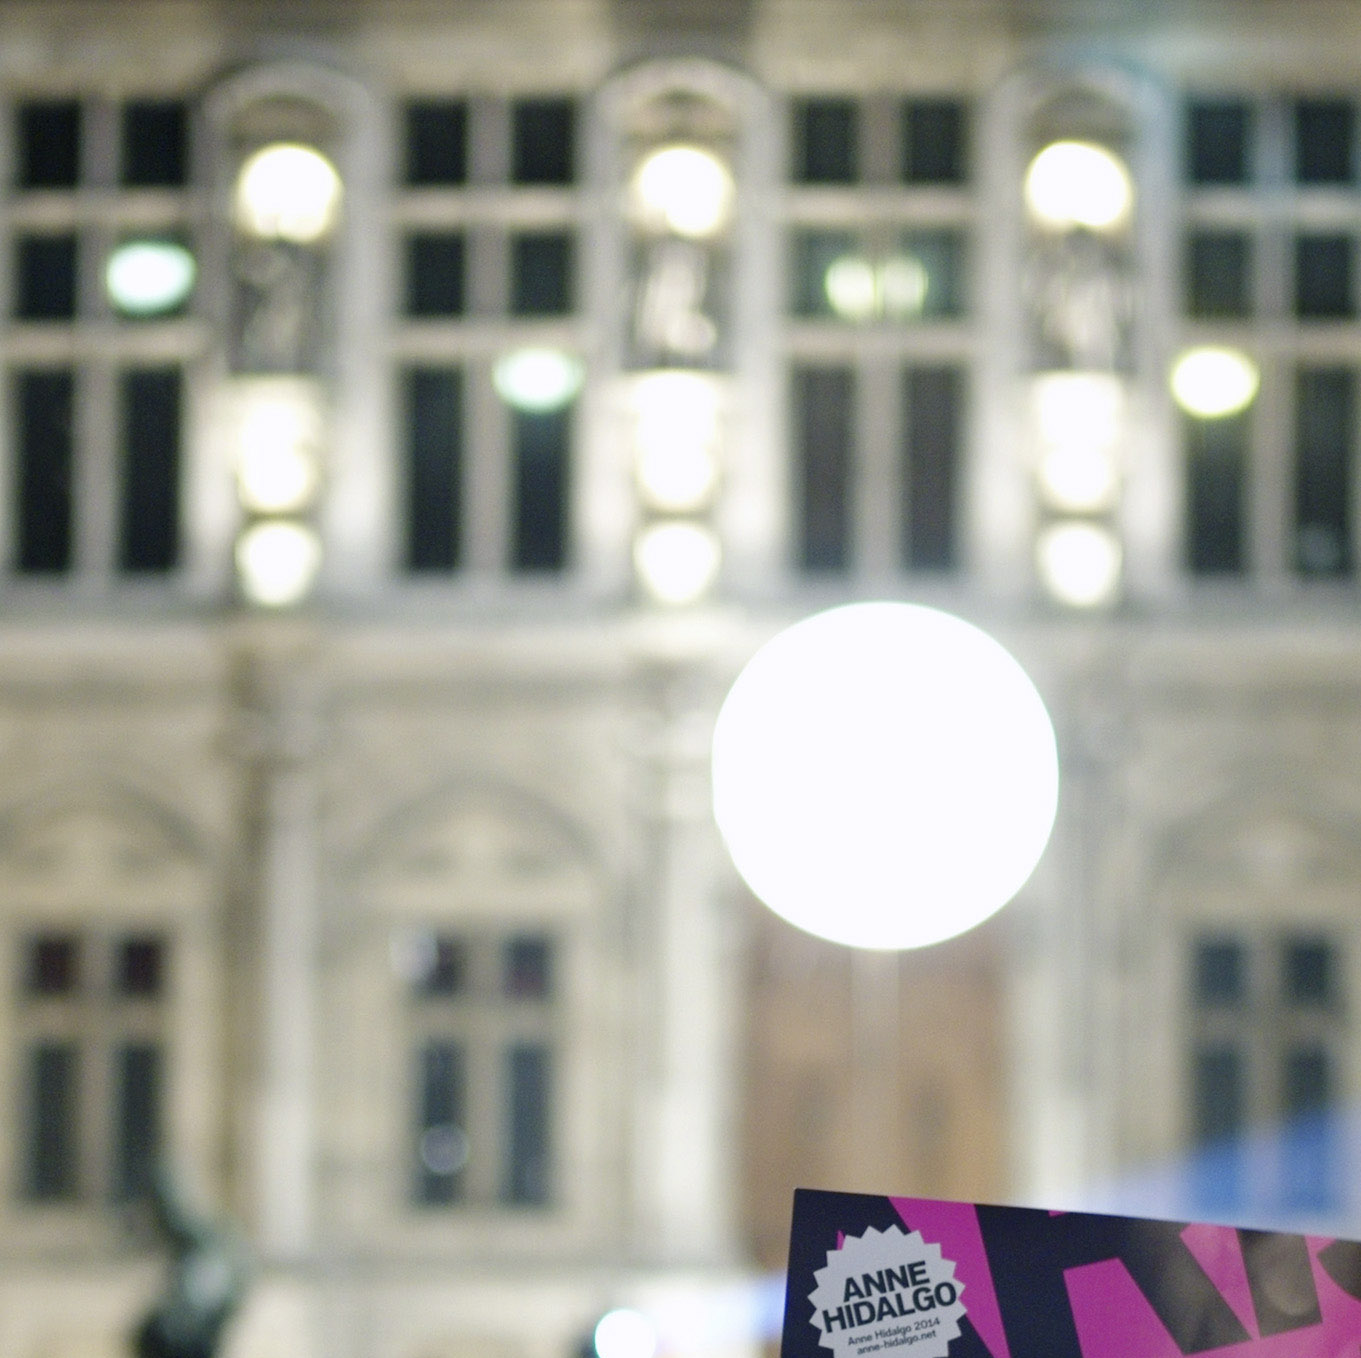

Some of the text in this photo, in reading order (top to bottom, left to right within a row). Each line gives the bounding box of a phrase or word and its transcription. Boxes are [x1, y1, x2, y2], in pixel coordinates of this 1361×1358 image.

[843, 1260, 930, 1302] ANNE
[822, 1282, 957, 1333] HIDALGO
[847, 1317, 941, 1346] Anne Hidalgo 2014
[857, 1330, 937, 1355] anne-hidalgo.net
